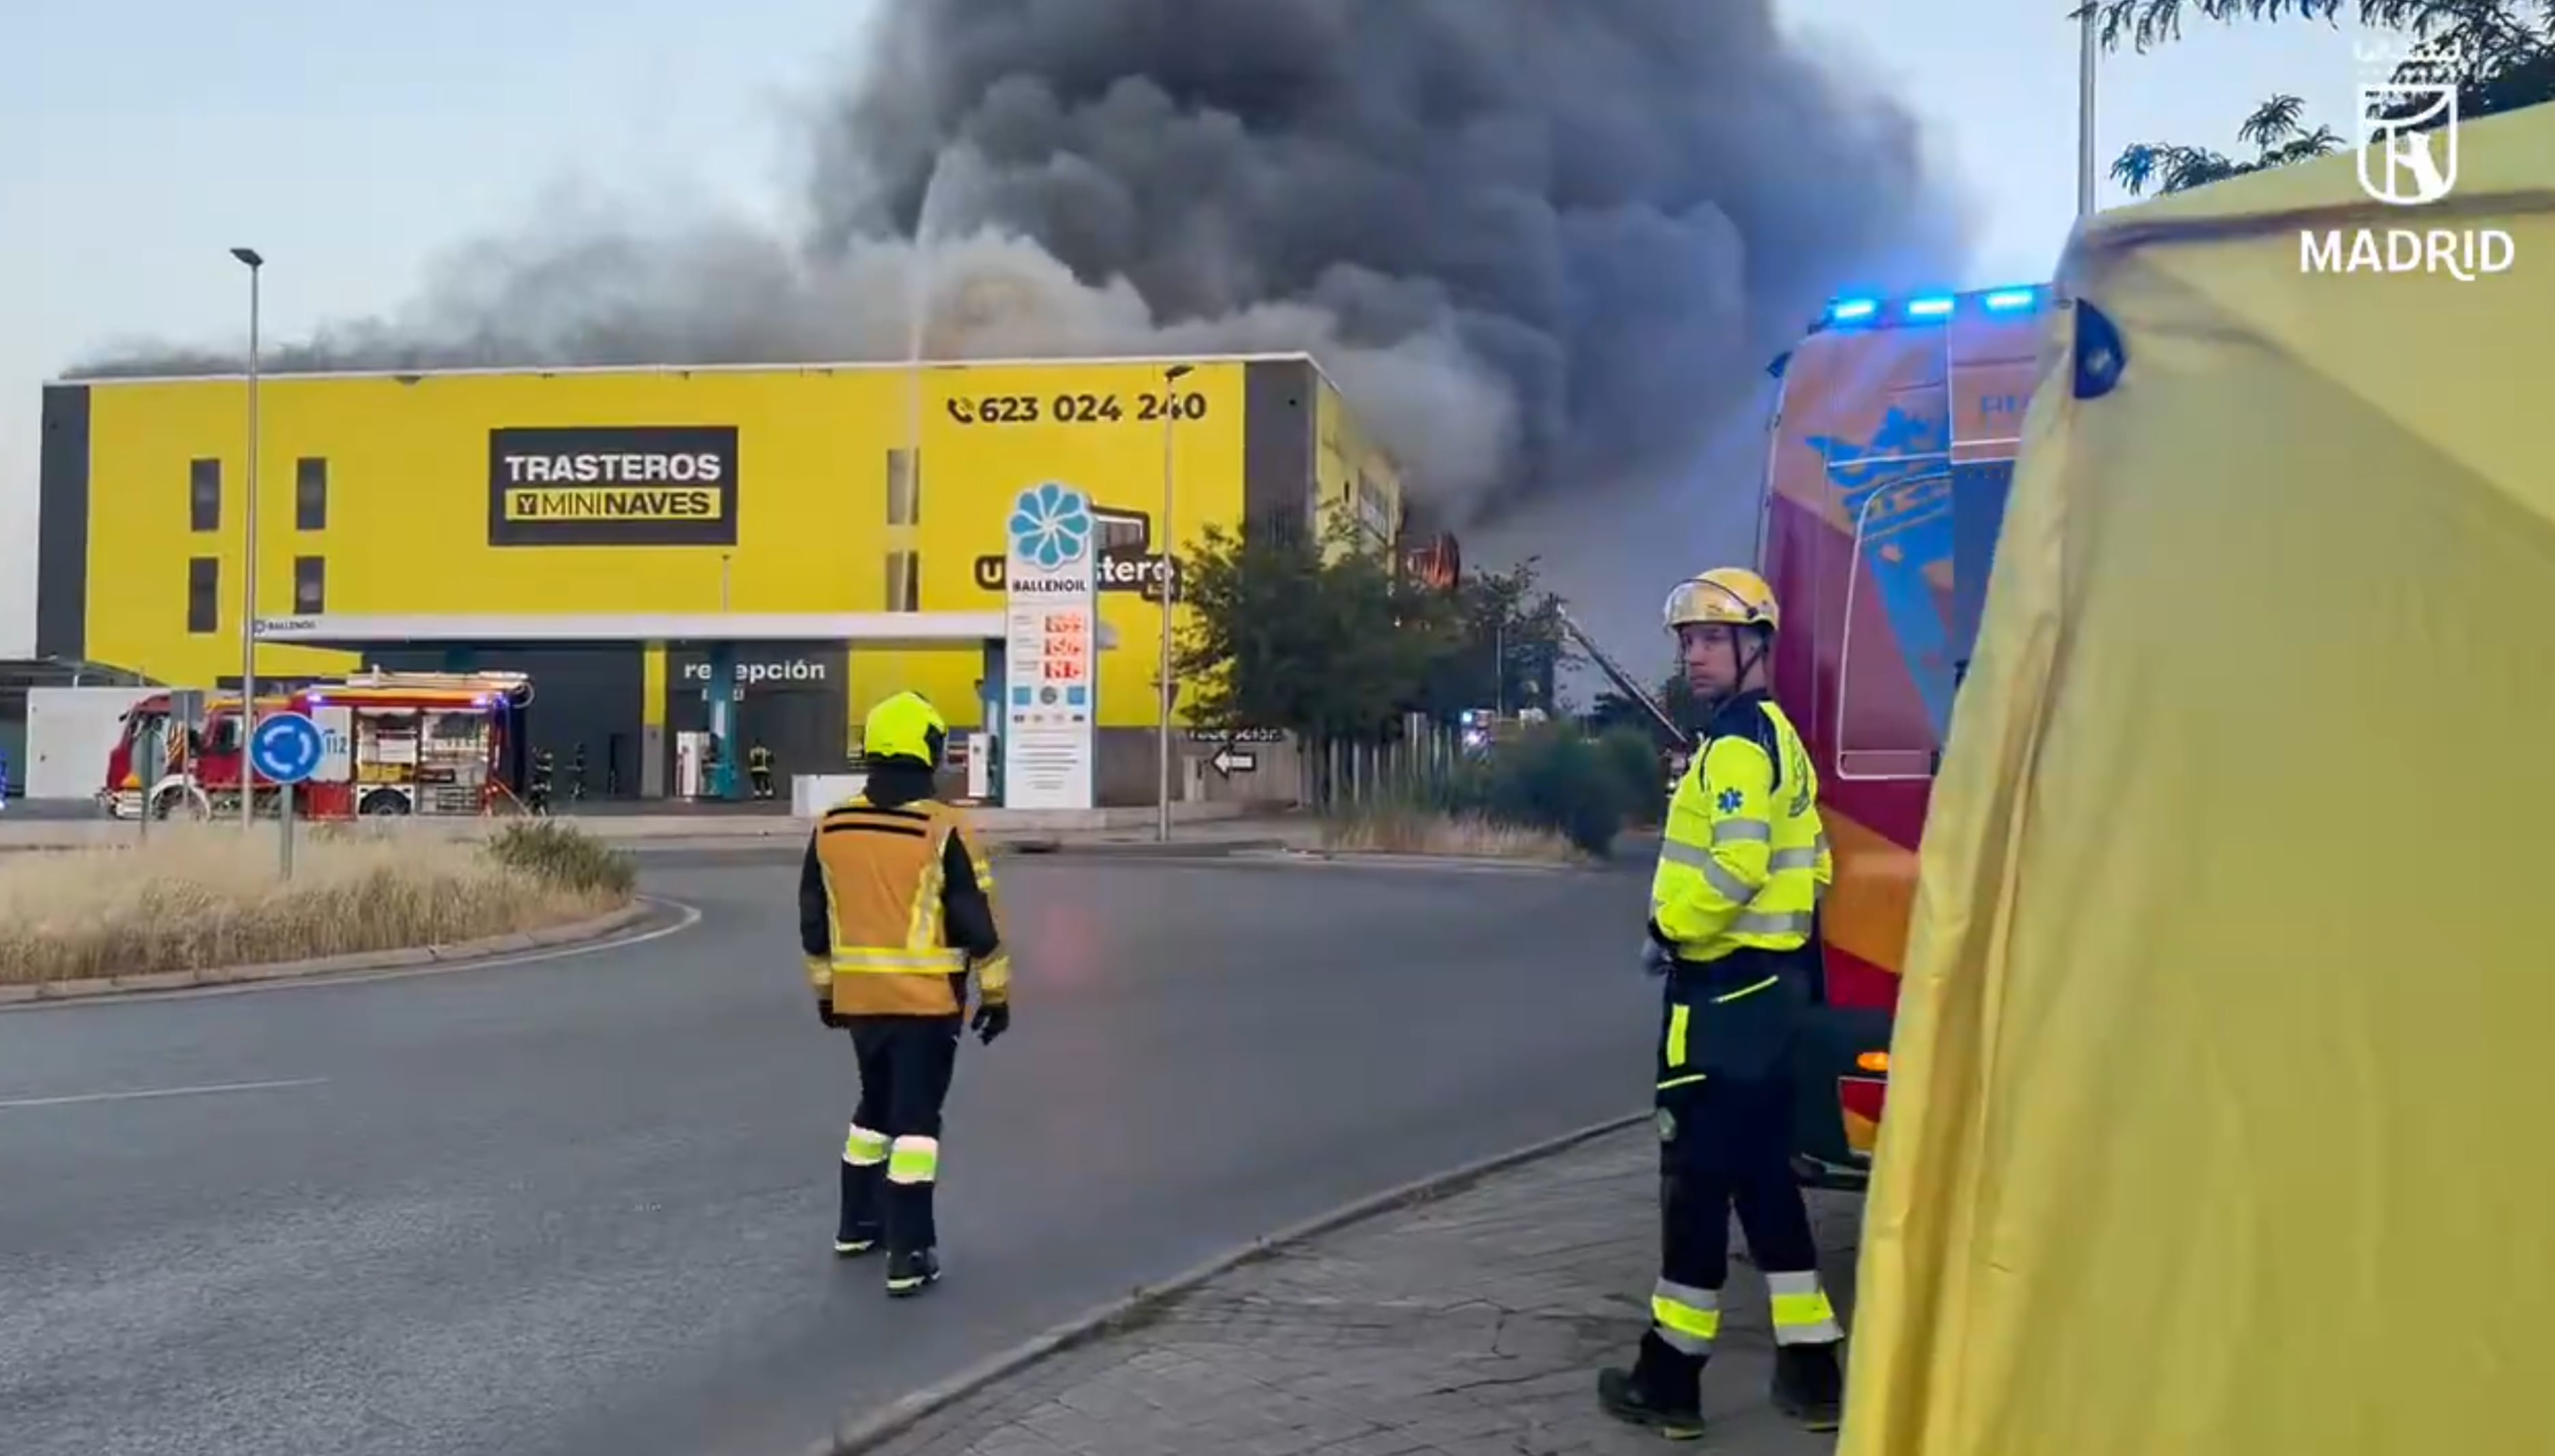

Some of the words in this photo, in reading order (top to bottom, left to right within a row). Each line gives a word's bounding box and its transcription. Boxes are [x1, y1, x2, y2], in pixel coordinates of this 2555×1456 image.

[979, 396, 1040, 423] 623
[1052, 394, 1123, 422] 024
[1137, 392, 1207, 421] 240
[503, 453, 722, 481] TRASTEROS
[1012, 580, 1087, 593] BALLENOIL
[684, 658, 826, 685] reepción
[326, 736, 348, 755] 112
